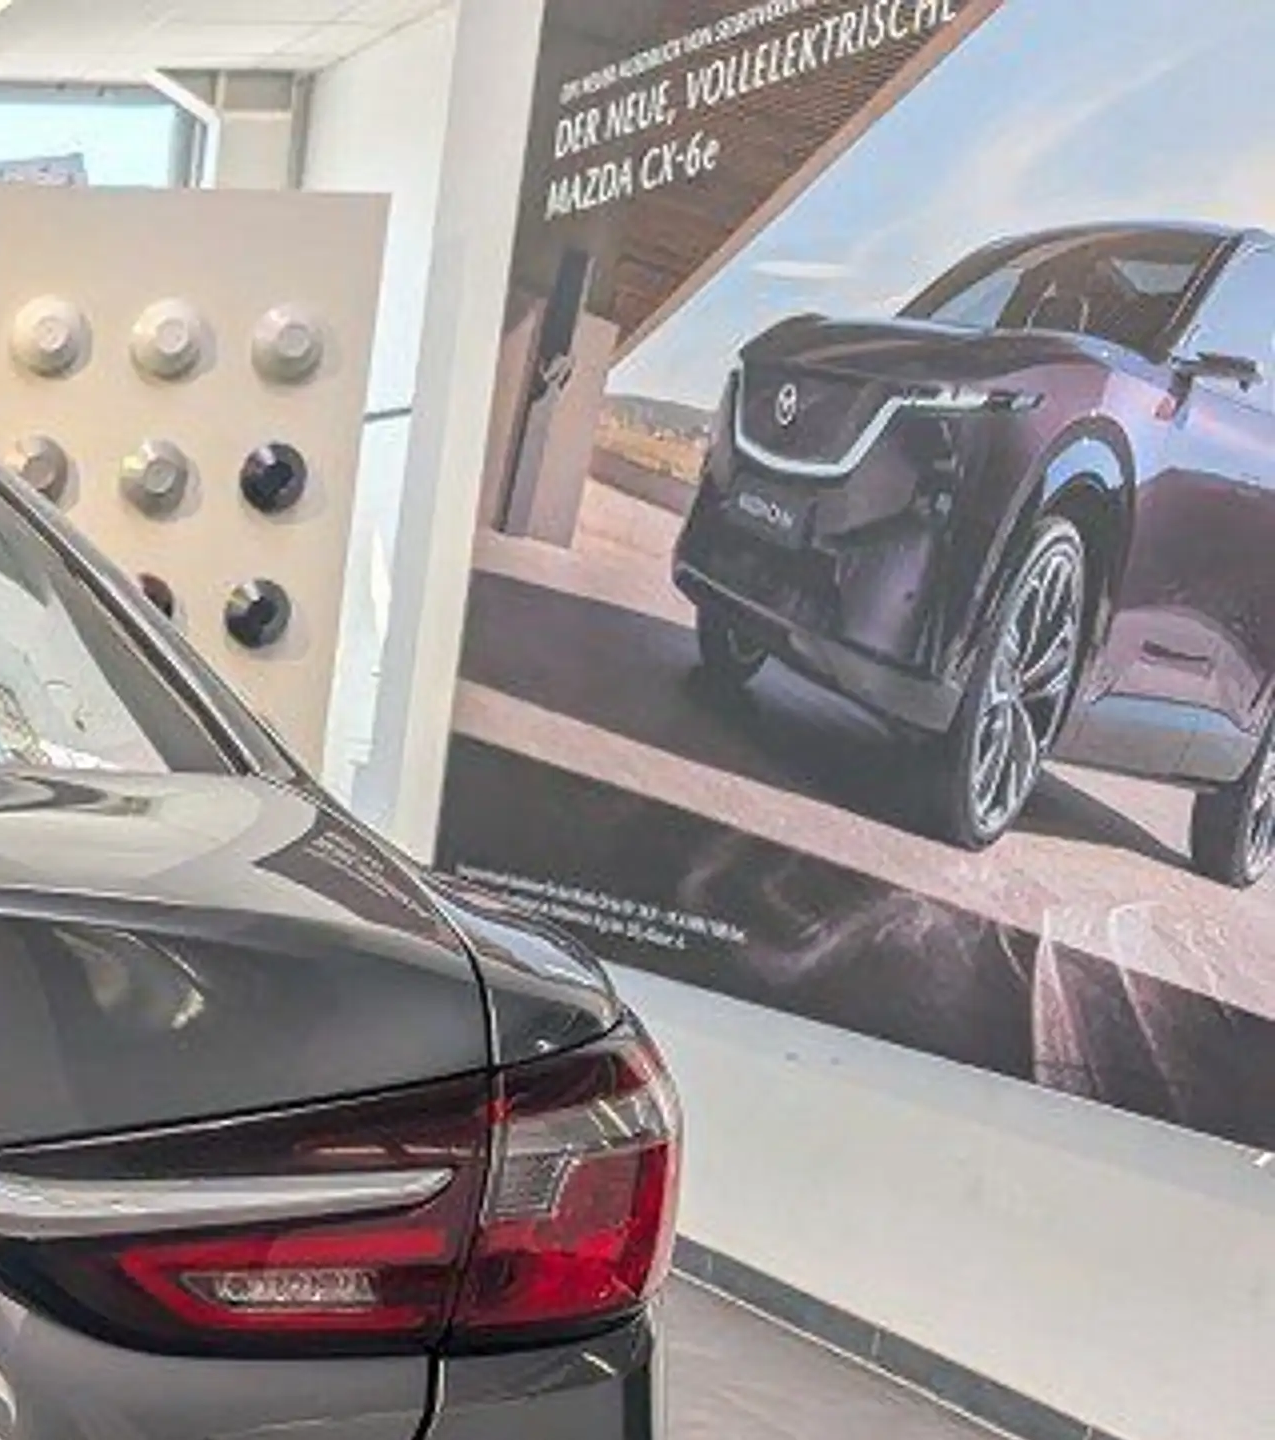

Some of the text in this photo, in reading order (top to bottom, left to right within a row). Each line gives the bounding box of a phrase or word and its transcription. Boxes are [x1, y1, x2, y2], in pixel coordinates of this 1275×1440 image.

[555, 108, 601, 160] DER
[604, 80, 677, 141] NEUE,
[545, 130, 721, 221] MAZDA CX-6e
